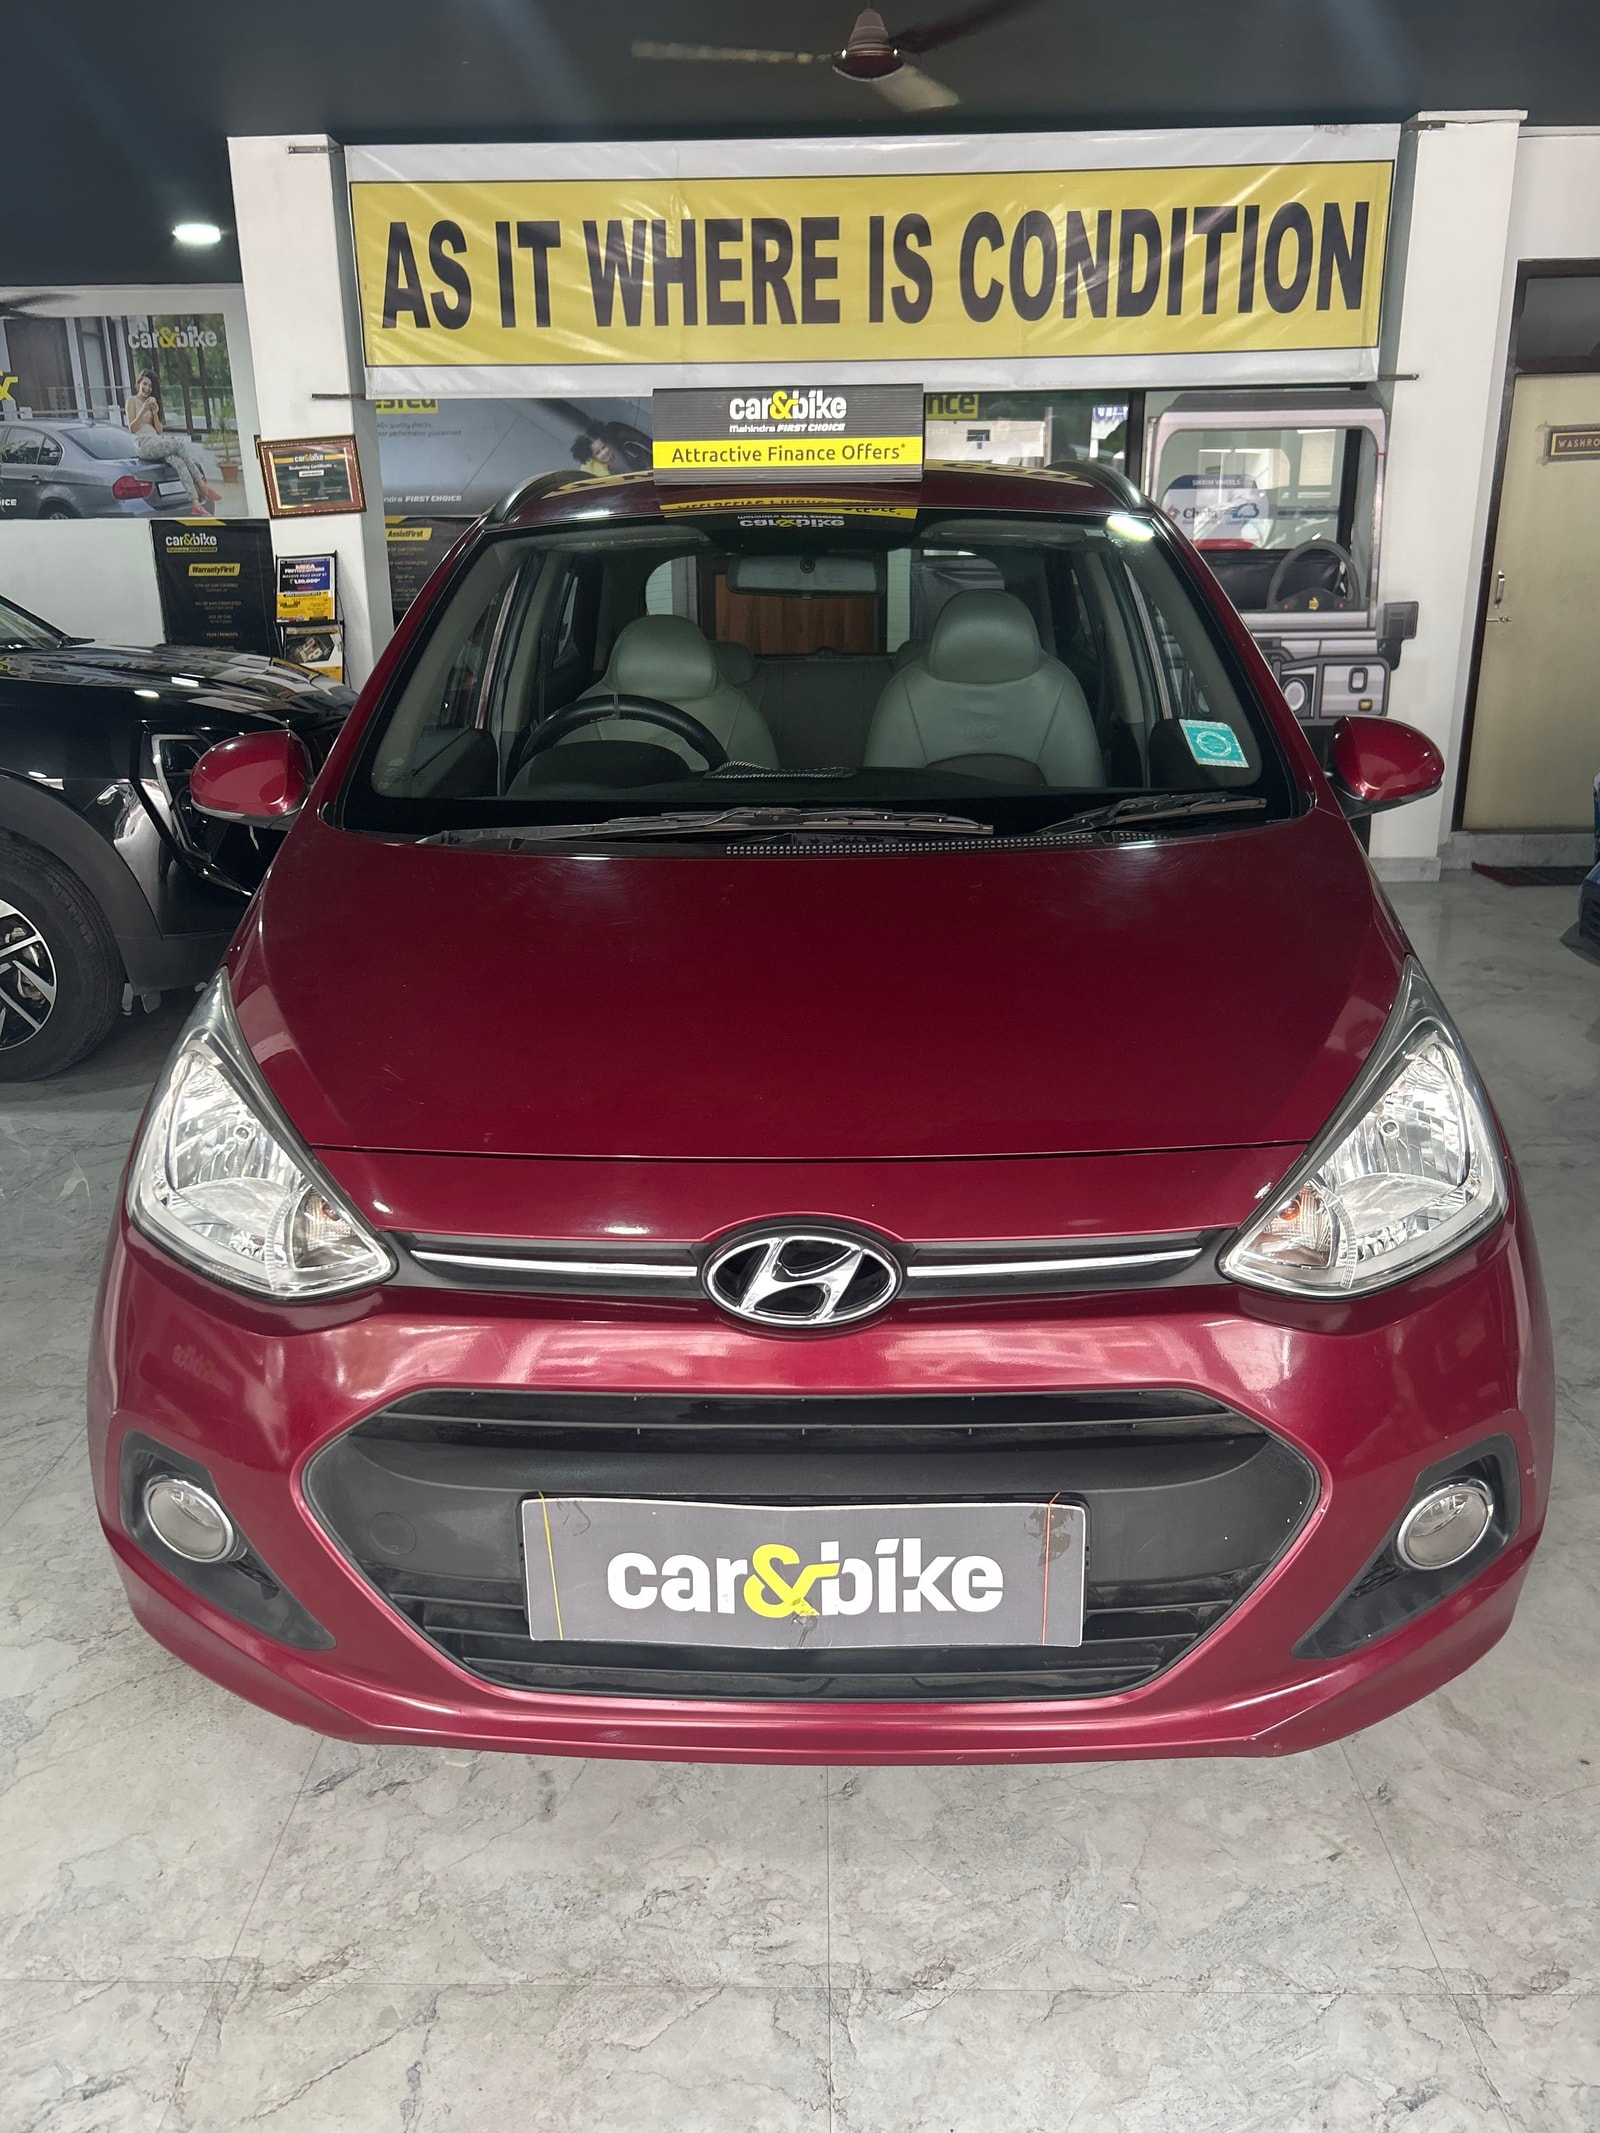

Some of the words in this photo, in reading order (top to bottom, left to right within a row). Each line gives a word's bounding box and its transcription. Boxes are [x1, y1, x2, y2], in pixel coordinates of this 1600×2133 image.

[382, 221, 471, 329] AS
[496, 221, 561, 328] IT
[583, 217, 839, 327] WHERE
[870, 212, 932, 323] IS
[960, 202, 1369, 323] CONDITION
[128, 326, 217, 348] car&bike
[729, 390, 847, 420] car&bike
[729, 424, 776, 433] Mahindra
[776, 424, 807, 432] FIRST
[807, 423, 846, 432] CHOICE
[1558, 438, 1600, 448] WASHRO
[671, 445, 762, 463] Attractive
[768, 445, 836, 461] Finance
[0, 498, 17, 506] ICE
[404, 495, 431, 503] FIRST
[165, 533, 217, 547] car&bike
[191, 565, 235, 575] WarrantyFirst
[606, 1537, 1004, 1618] car&bike
